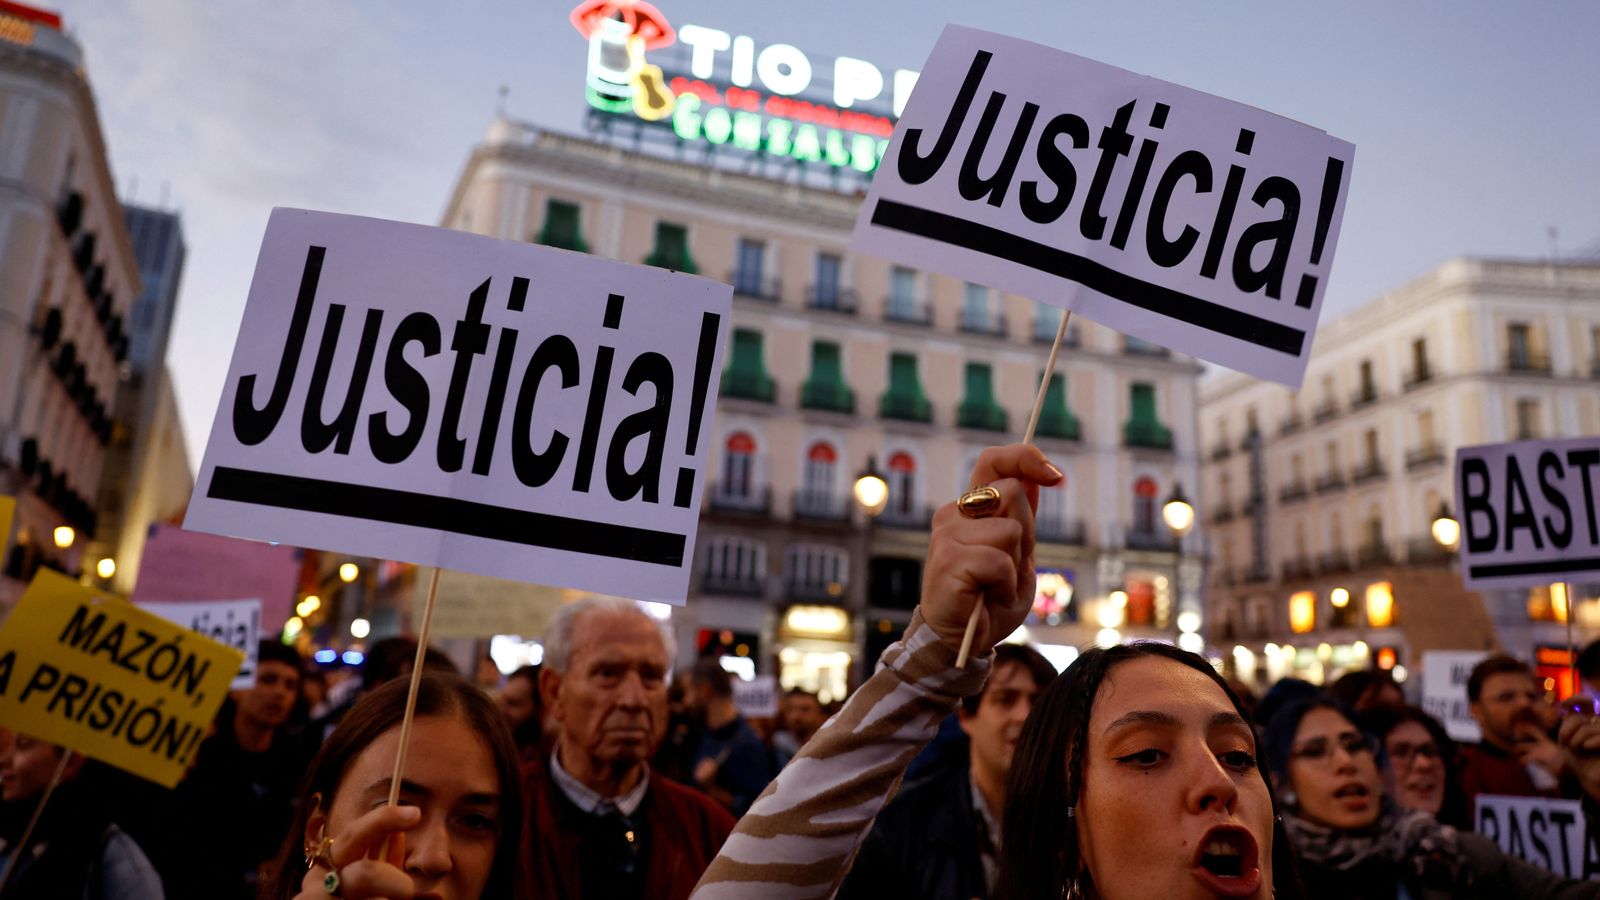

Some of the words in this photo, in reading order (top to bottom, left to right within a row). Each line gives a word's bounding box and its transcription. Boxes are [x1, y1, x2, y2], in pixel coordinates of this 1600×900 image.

[678, 24, 812, 95] TIO
[898, 50, 1344, 309] Justicia!
[233, 246, 720, 508] Justicia!
[1461, 451, 1600, 554] BAST
[58, 604, 211, 707] MAZÓN,
[18, 662, 202, 765] PRISIÓN!
